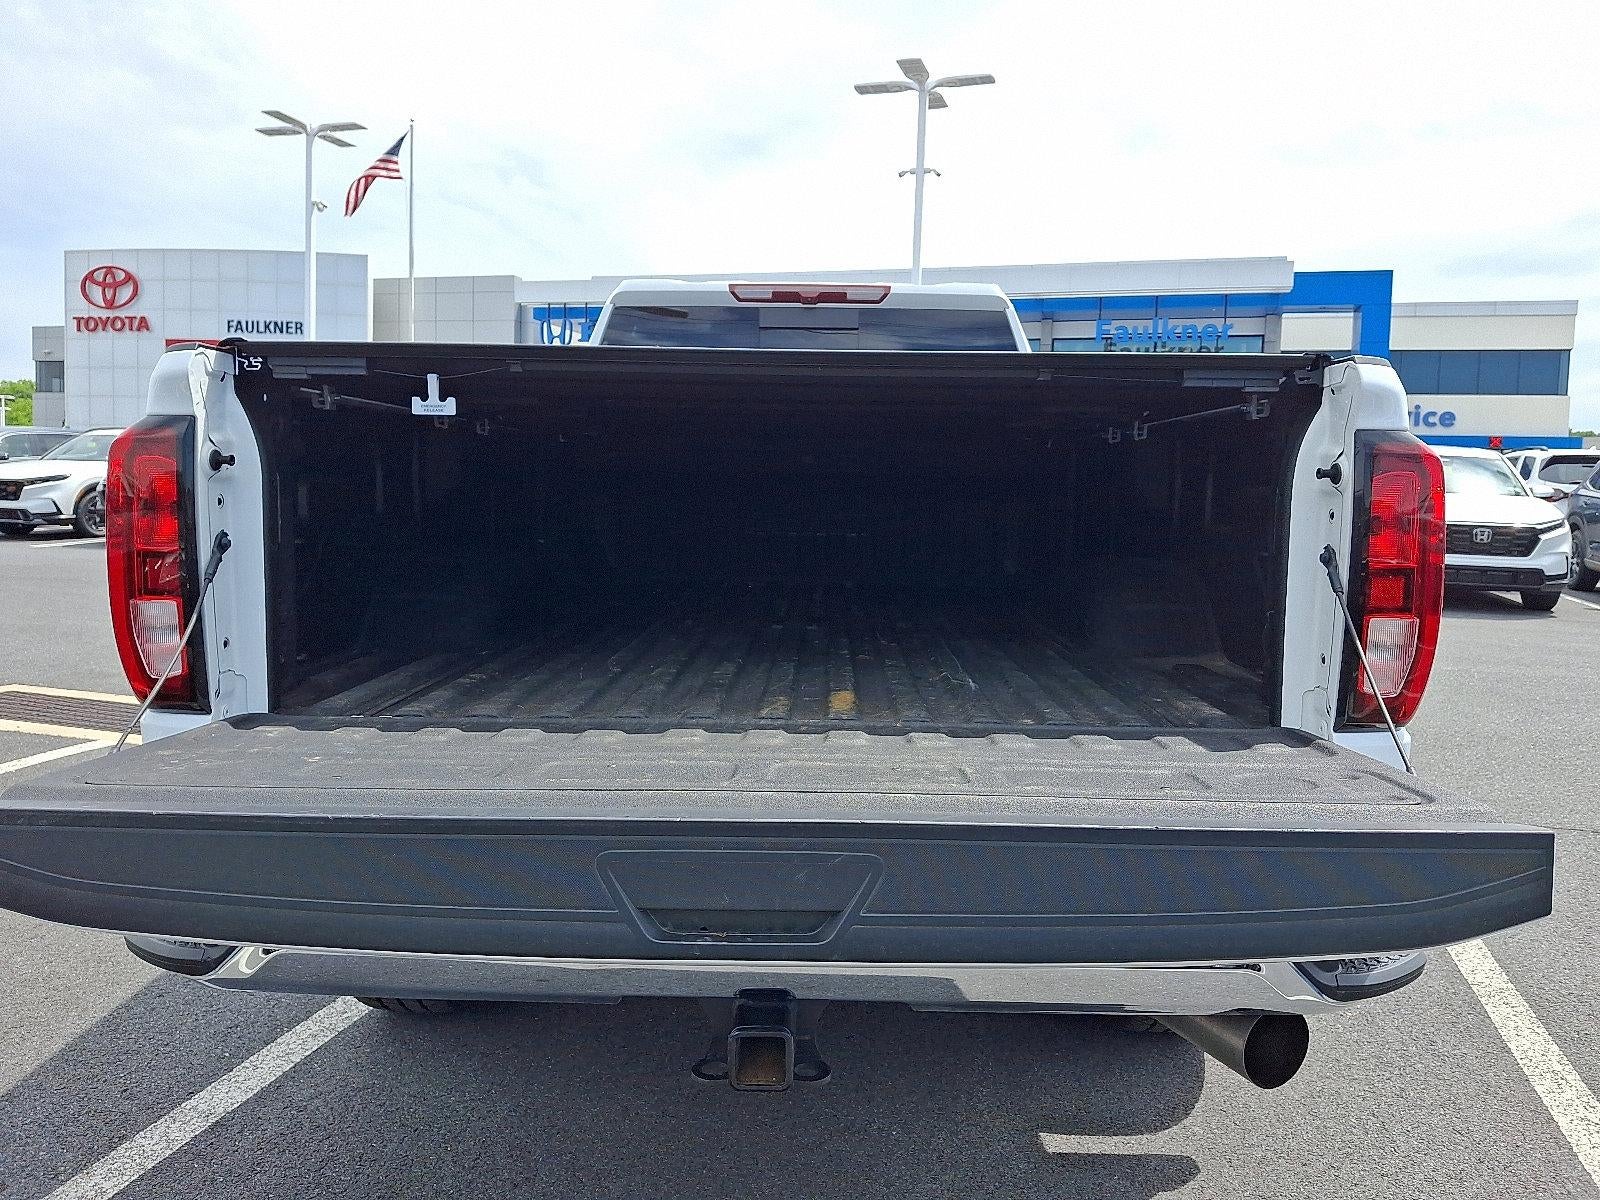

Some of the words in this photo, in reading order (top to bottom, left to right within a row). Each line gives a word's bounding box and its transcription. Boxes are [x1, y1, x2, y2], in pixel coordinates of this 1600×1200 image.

[73, 316, 150, 332] TOYOTA
[227, 319, 303, 334] FAULKNER
[1095, 317, 1233, 343] Faulkner
